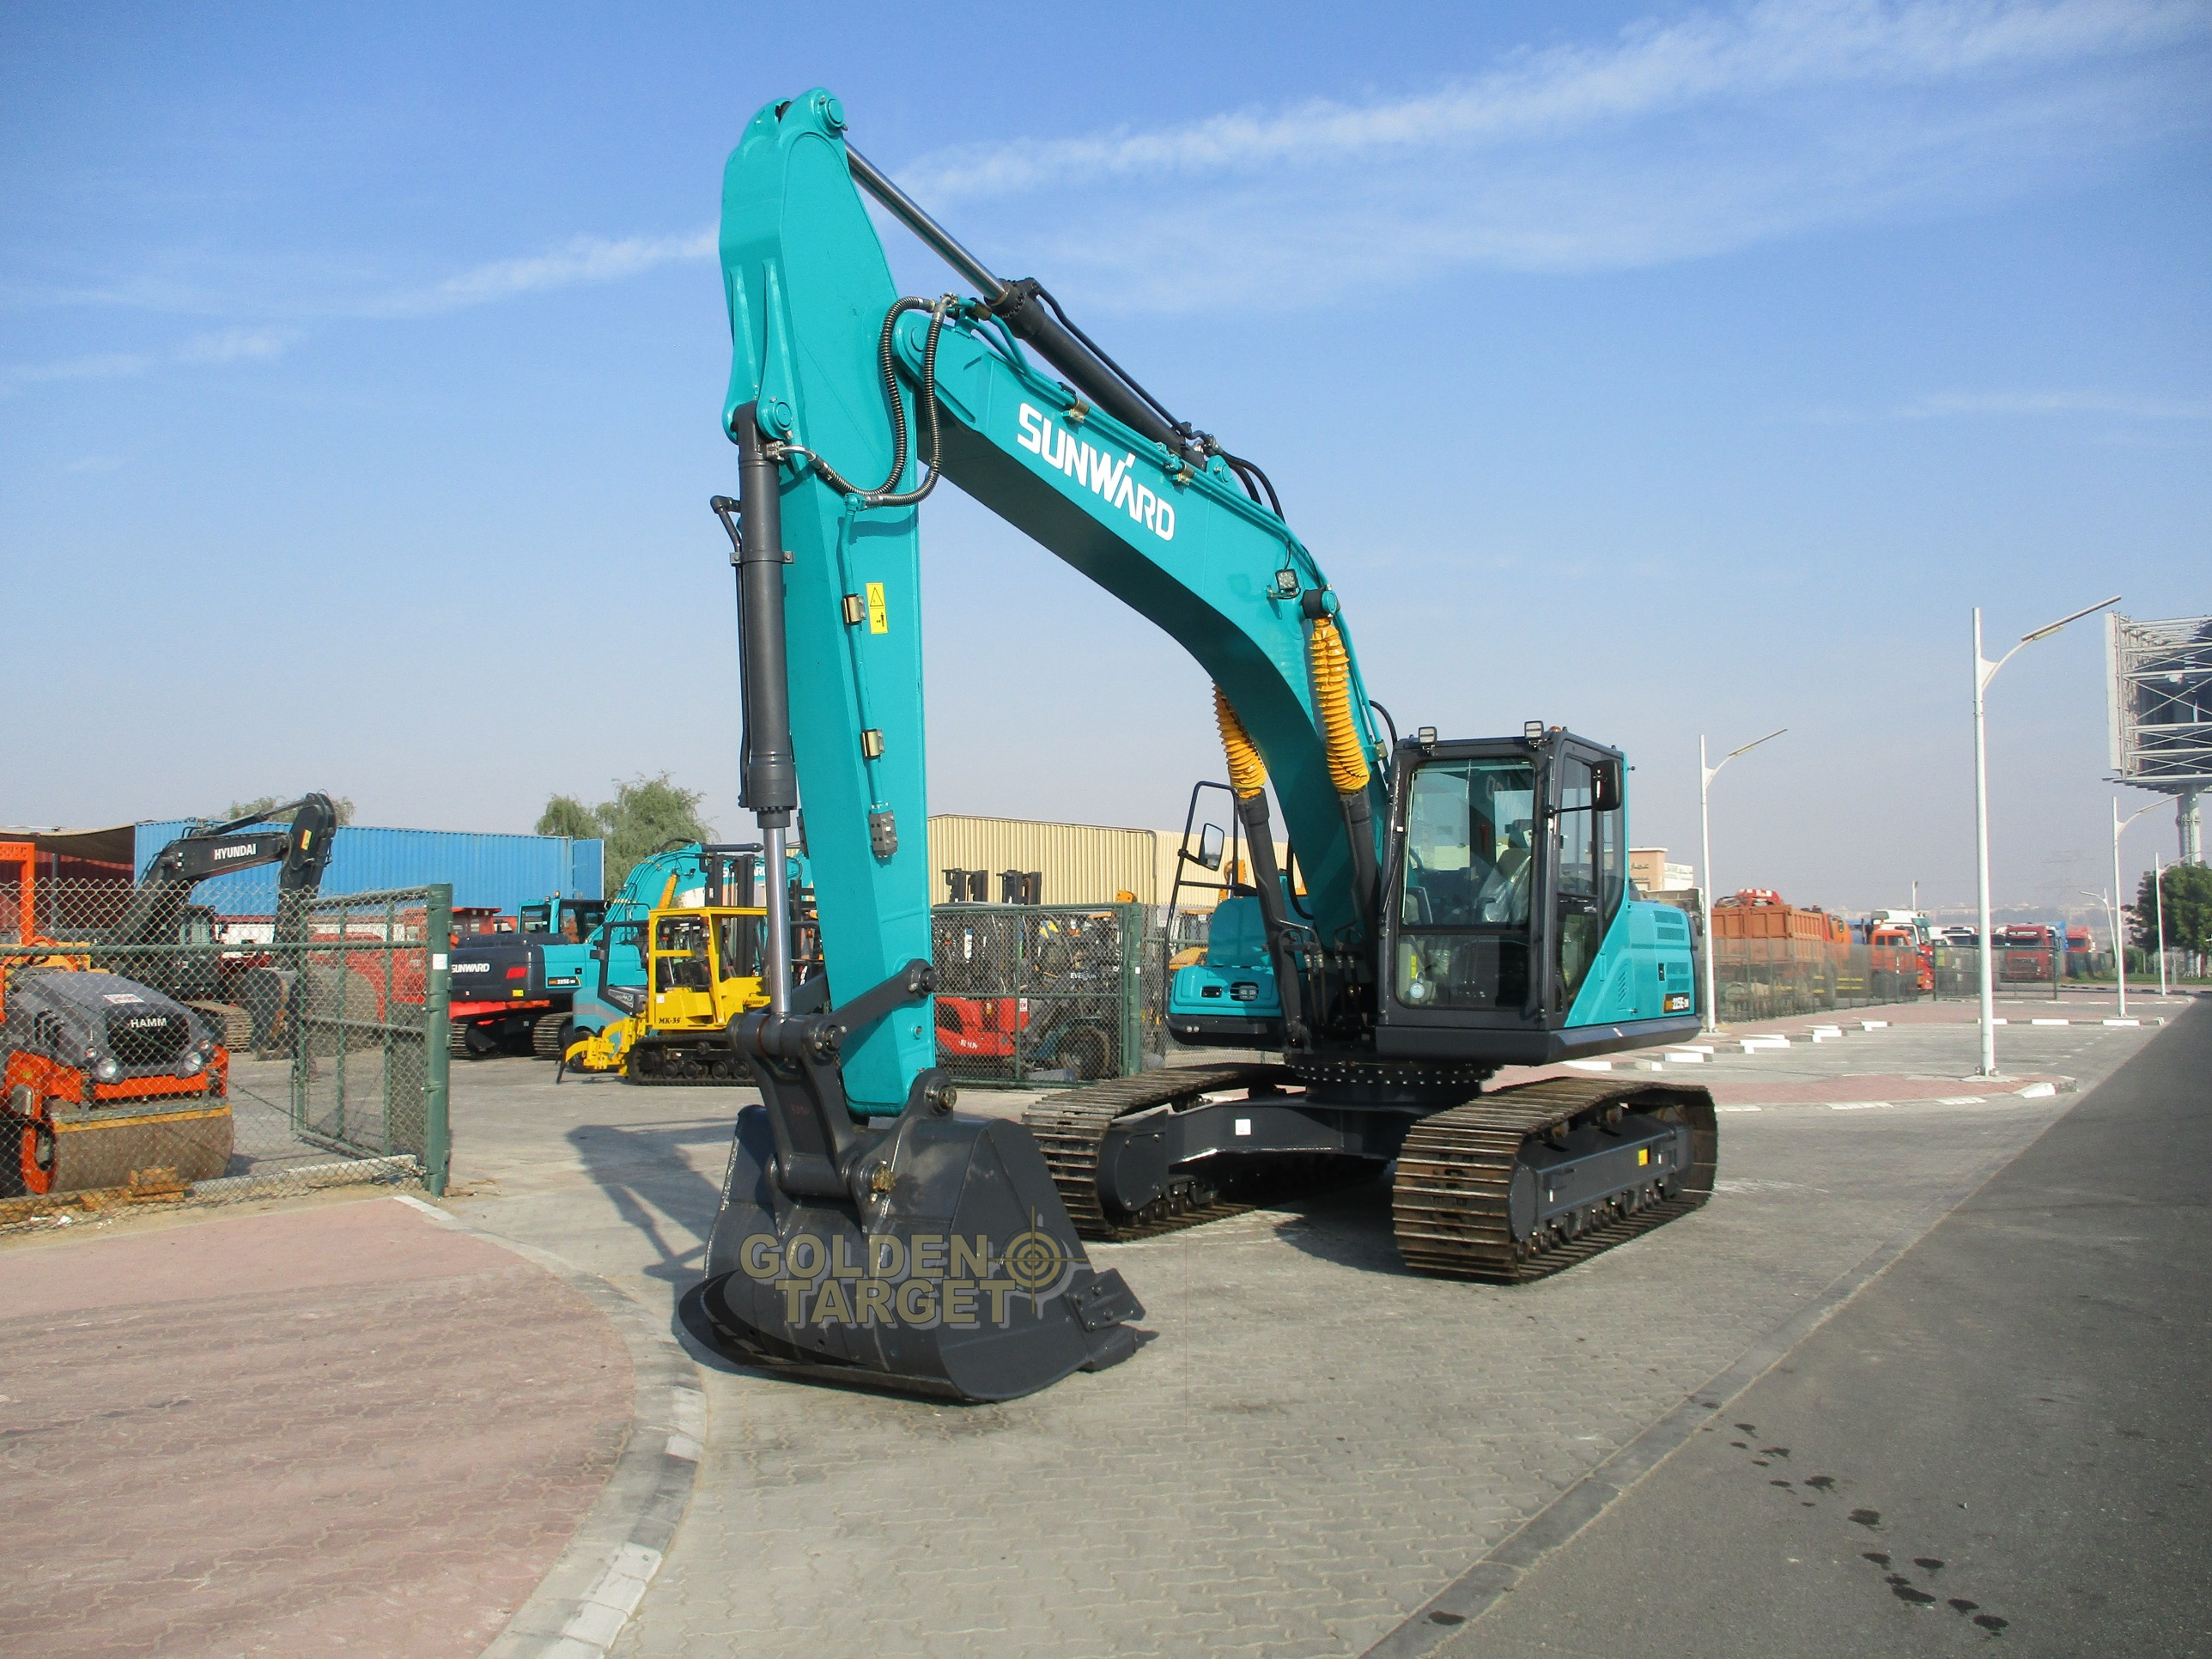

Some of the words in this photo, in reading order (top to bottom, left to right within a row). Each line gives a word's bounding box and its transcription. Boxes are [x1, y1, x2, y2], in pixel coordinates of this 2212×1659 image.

[1017, 402, 1176, 541] SUNWARD
[214, 843, 257, 860] HYUNDAI
[451, 963, 490, 974] SUNWARD
[131, 1018, 167, 1028] HAMM
